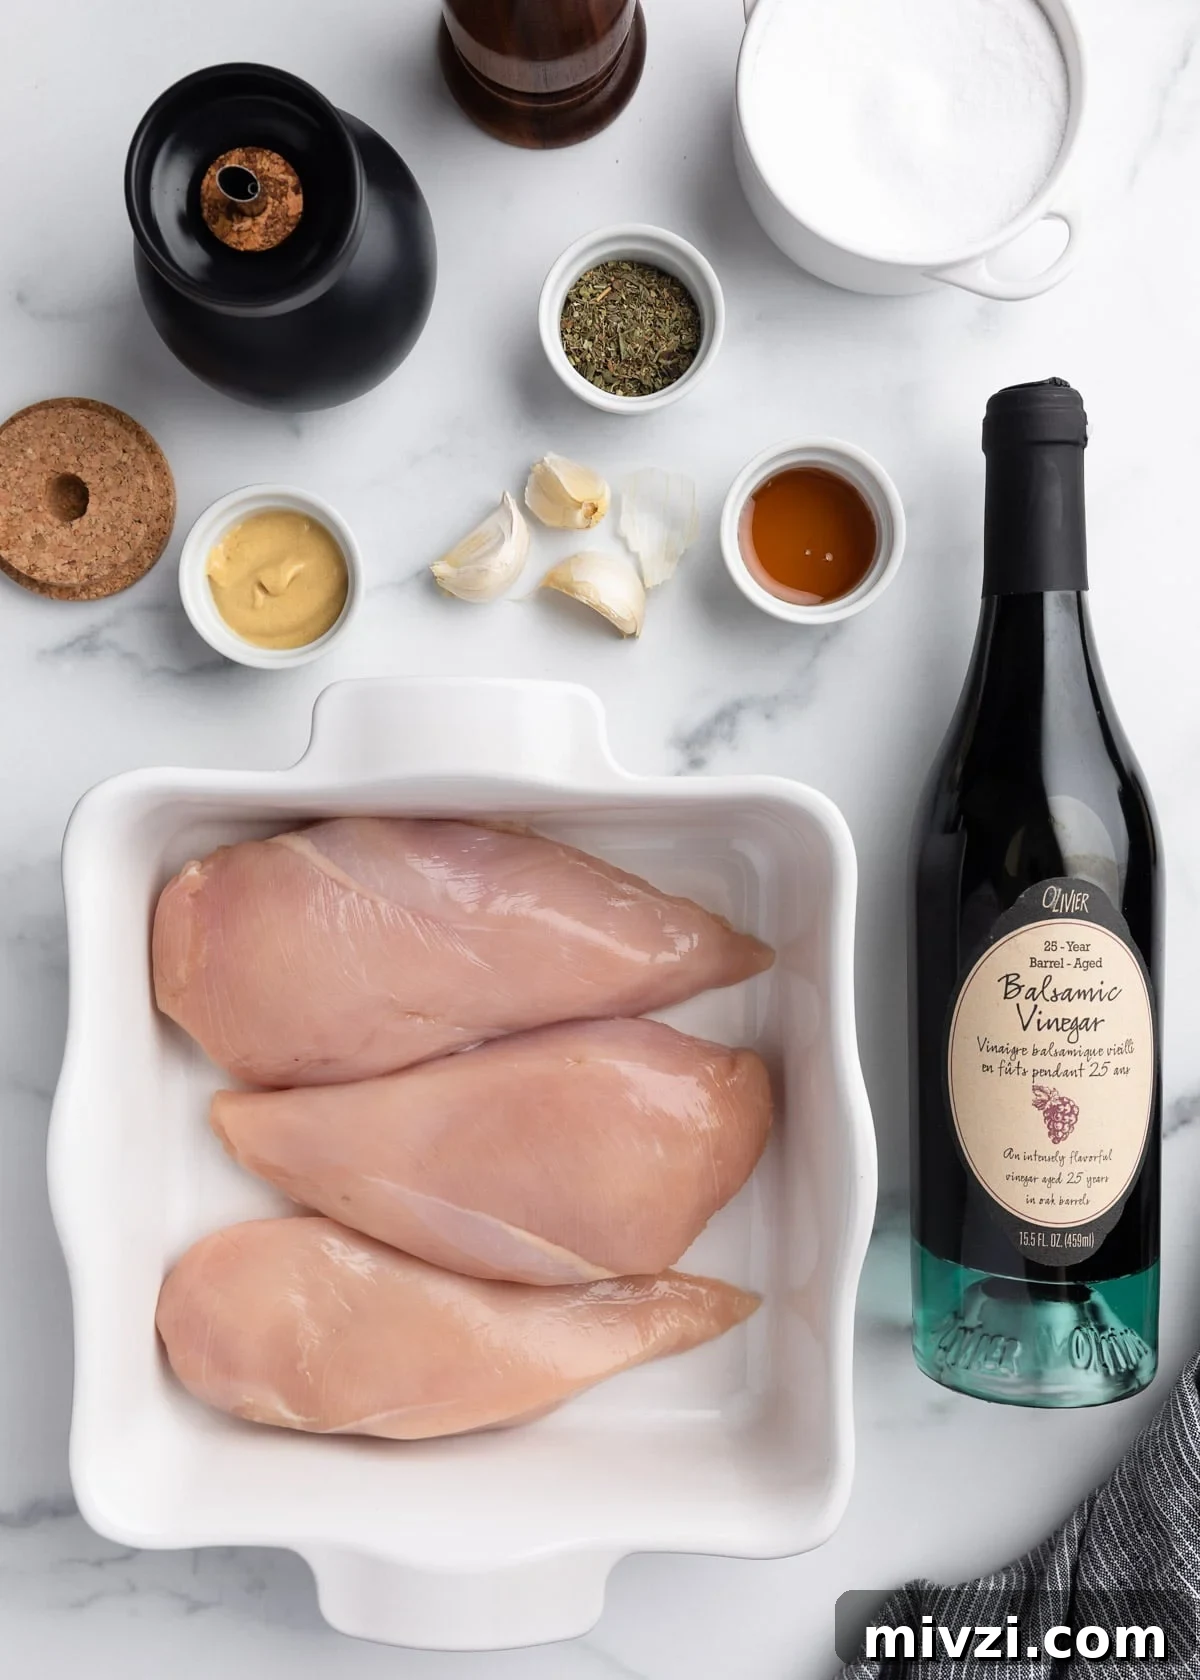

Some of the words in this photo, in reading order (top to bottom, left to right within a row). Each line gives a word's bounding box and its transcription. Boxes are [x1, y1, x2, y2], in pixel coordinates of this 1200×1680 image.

[1042, 885, 1090, 913] OLIVIER
[1044, 940, 1058, 952] 25
[1065, 940, 1091, 952] Year
[1029, 956, 1064, 969] Barrel
[1073, 956, 1103, 972] Aged
[997, 972, 1123, 1003] Balsamic
[1016, 1003, 1105, 1044] Vinegar
[976, 1035, 1028, 1061] Vinaigre
[1032, 1040, 1104, 1062] balsamique
[981, 1063, 995, 1074] en
[998, 1060, 1029, 1077] fûts
[1032, 1062, 1085, 1083] pendant
[1089, 1061, 1111, 1077] 25
[1113, 1065, 1131, 1077] ans
[1003, 1147, 1020, 1161] An
[1023, 1149, 1066, 1167] intensely
[1069, 1148, 1113, 1164] flavorful
[1005, 1171, 1039, 1187] vinegar
[1042, 1172, 1063, 1188] aged
[1066, 1171, 1084, 1184] 25
[1086, 1175, 1109, 1188] years
[1025, 1194, 1036, 1205] in
[1038, 1193, 1056, 1205] oak
[1058, 1193, 1091, 1206] barrels
[1018, 1231, 1036, 1246] 15.5
[1064, 1231, 1095, 1249] (459ml)
